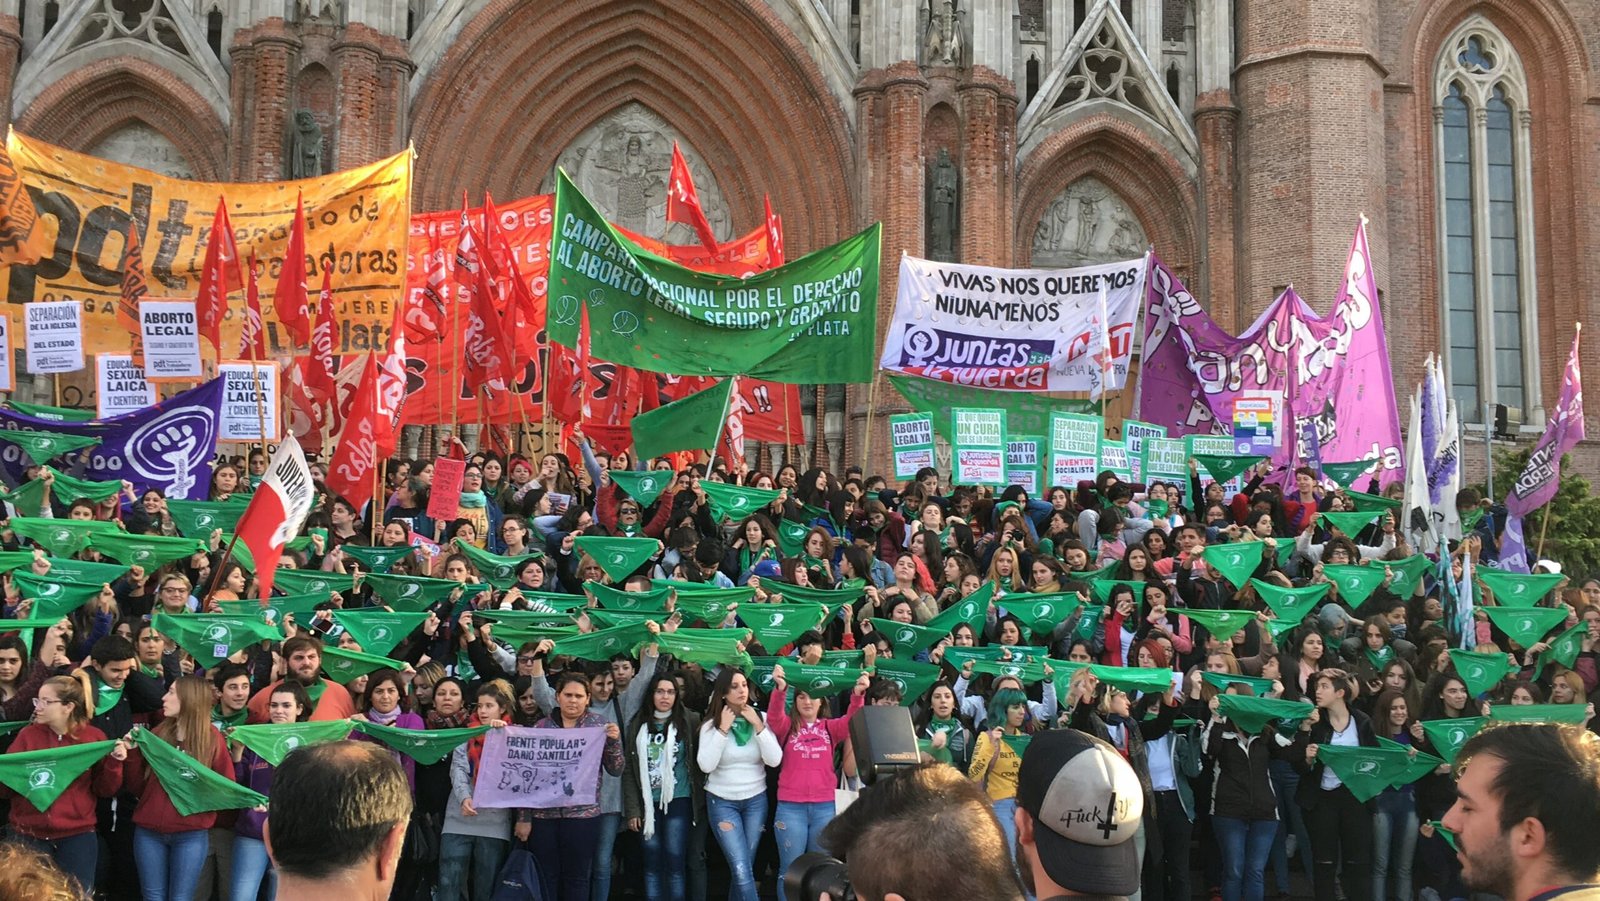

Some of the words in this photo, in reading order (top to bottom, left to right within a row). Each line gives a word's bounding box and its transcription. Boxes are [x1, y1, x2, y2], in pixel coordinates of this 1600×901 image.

[8, 181, 193, 304] pdt
[556, 239, 574, 269] AL
[576, 250, 643, 296] ABORTO
[704, 310, 771, 330] SEGURO
[775, 309, 787, 328] Y
[938, 269, 995, 293] VIVAS
[1000, 277, 1040, 296] NOS
[1044, 267, 1138, 297] QUEREMOS
[726, 288, 760, 309] POR
[767, 287, 786, 308] EL
[793, 267, 863, 304] DERECHO
[30, 303, 76, 322] SEPARACIÓN
[144, 312, 194, 324] ABORTO
[50, 322, 77, 330] IGLESIA
[146, 326, 194, 336] LEGAL
[34, 341, 46, 349] DEL
[48, 340, 75, 348] ESTADO
[153, 360, 166, 369] pdt
[107, 381, 148, 392] LAICA
[108, 396, 113, 406] Y
[114, 395, 149, 406] CIENTÍFICA
[228, 406, 232, 415] Y
[228, 423, 241, 432] pdt
[894, 421, 930, 434] ABORTO
[958, 423, 971, 435] UN
[973, 423, 1000, 435] CURA
[1128, 425, 1162, 438] ABORTO
[895, 435, 919, 446] LEGAL
[921, 433, 931, 443] YA
[1055, 430, 1062, 439] DE
[1063, 431, 1071, 440] LA
[1007, 442, 1036, 453] BORTO
[1054, 440, 1067, 449] DEL
[1068, 441, 1096, 453] ESTADO
[1024, 454, 1036, 463] YA
[1149, 450, 1162, 463] UN
[1055, 459, 1094, 467] JUVENTUD
[1055, 466, 1095, 474] SOCIALISTA
[506, 736, 537, 749] FRENTE
[539, 738, 580, 749] POPULAR
[508, 749, 535, 760] DARIO
[1060, 805, 1105, 828] Fuck
